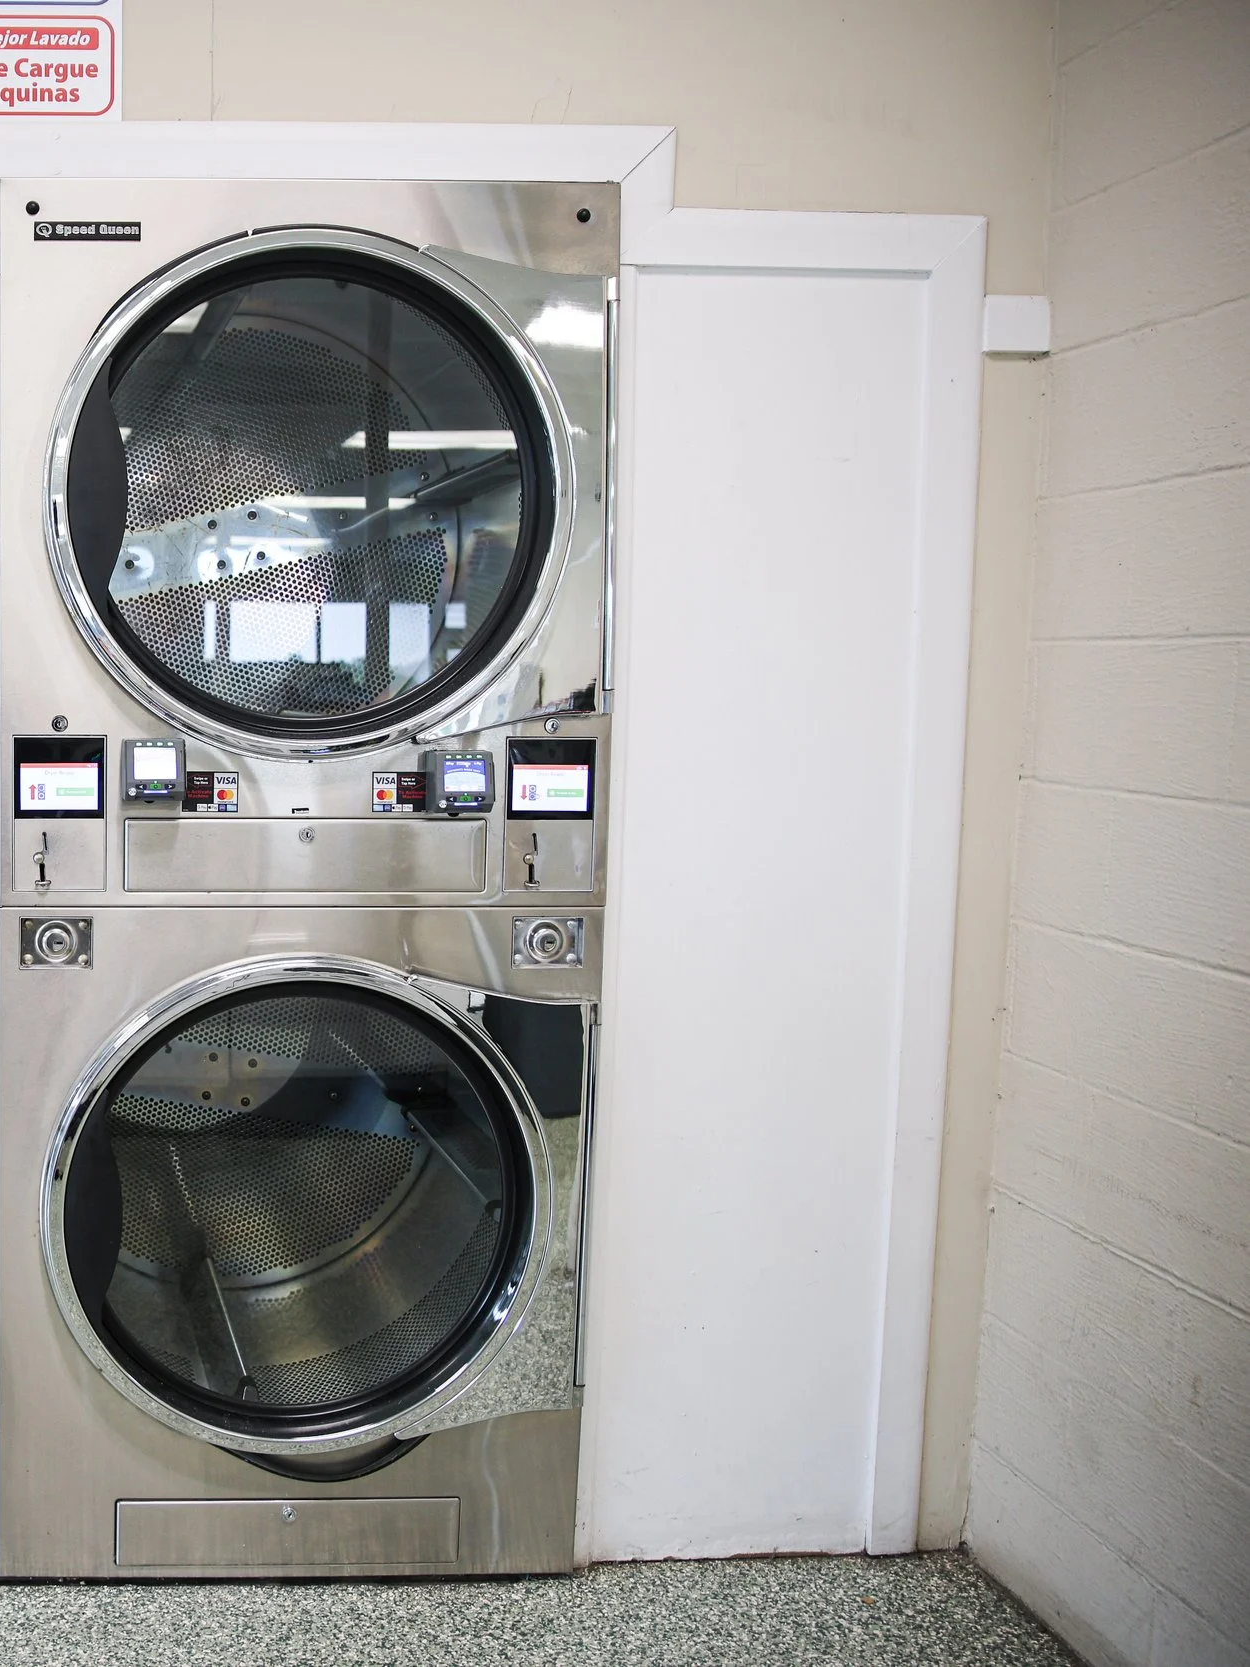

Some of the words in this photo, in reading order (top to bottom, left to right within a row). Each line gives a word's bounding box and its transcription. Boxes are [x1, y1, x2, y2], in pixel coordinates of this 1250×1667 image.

[30, 30, 91, 46] Lavado
[14, 58, 99, 83] Cargue
[55, 224, 96, 237] Speed
[99, 224, 139, 235] Queen
